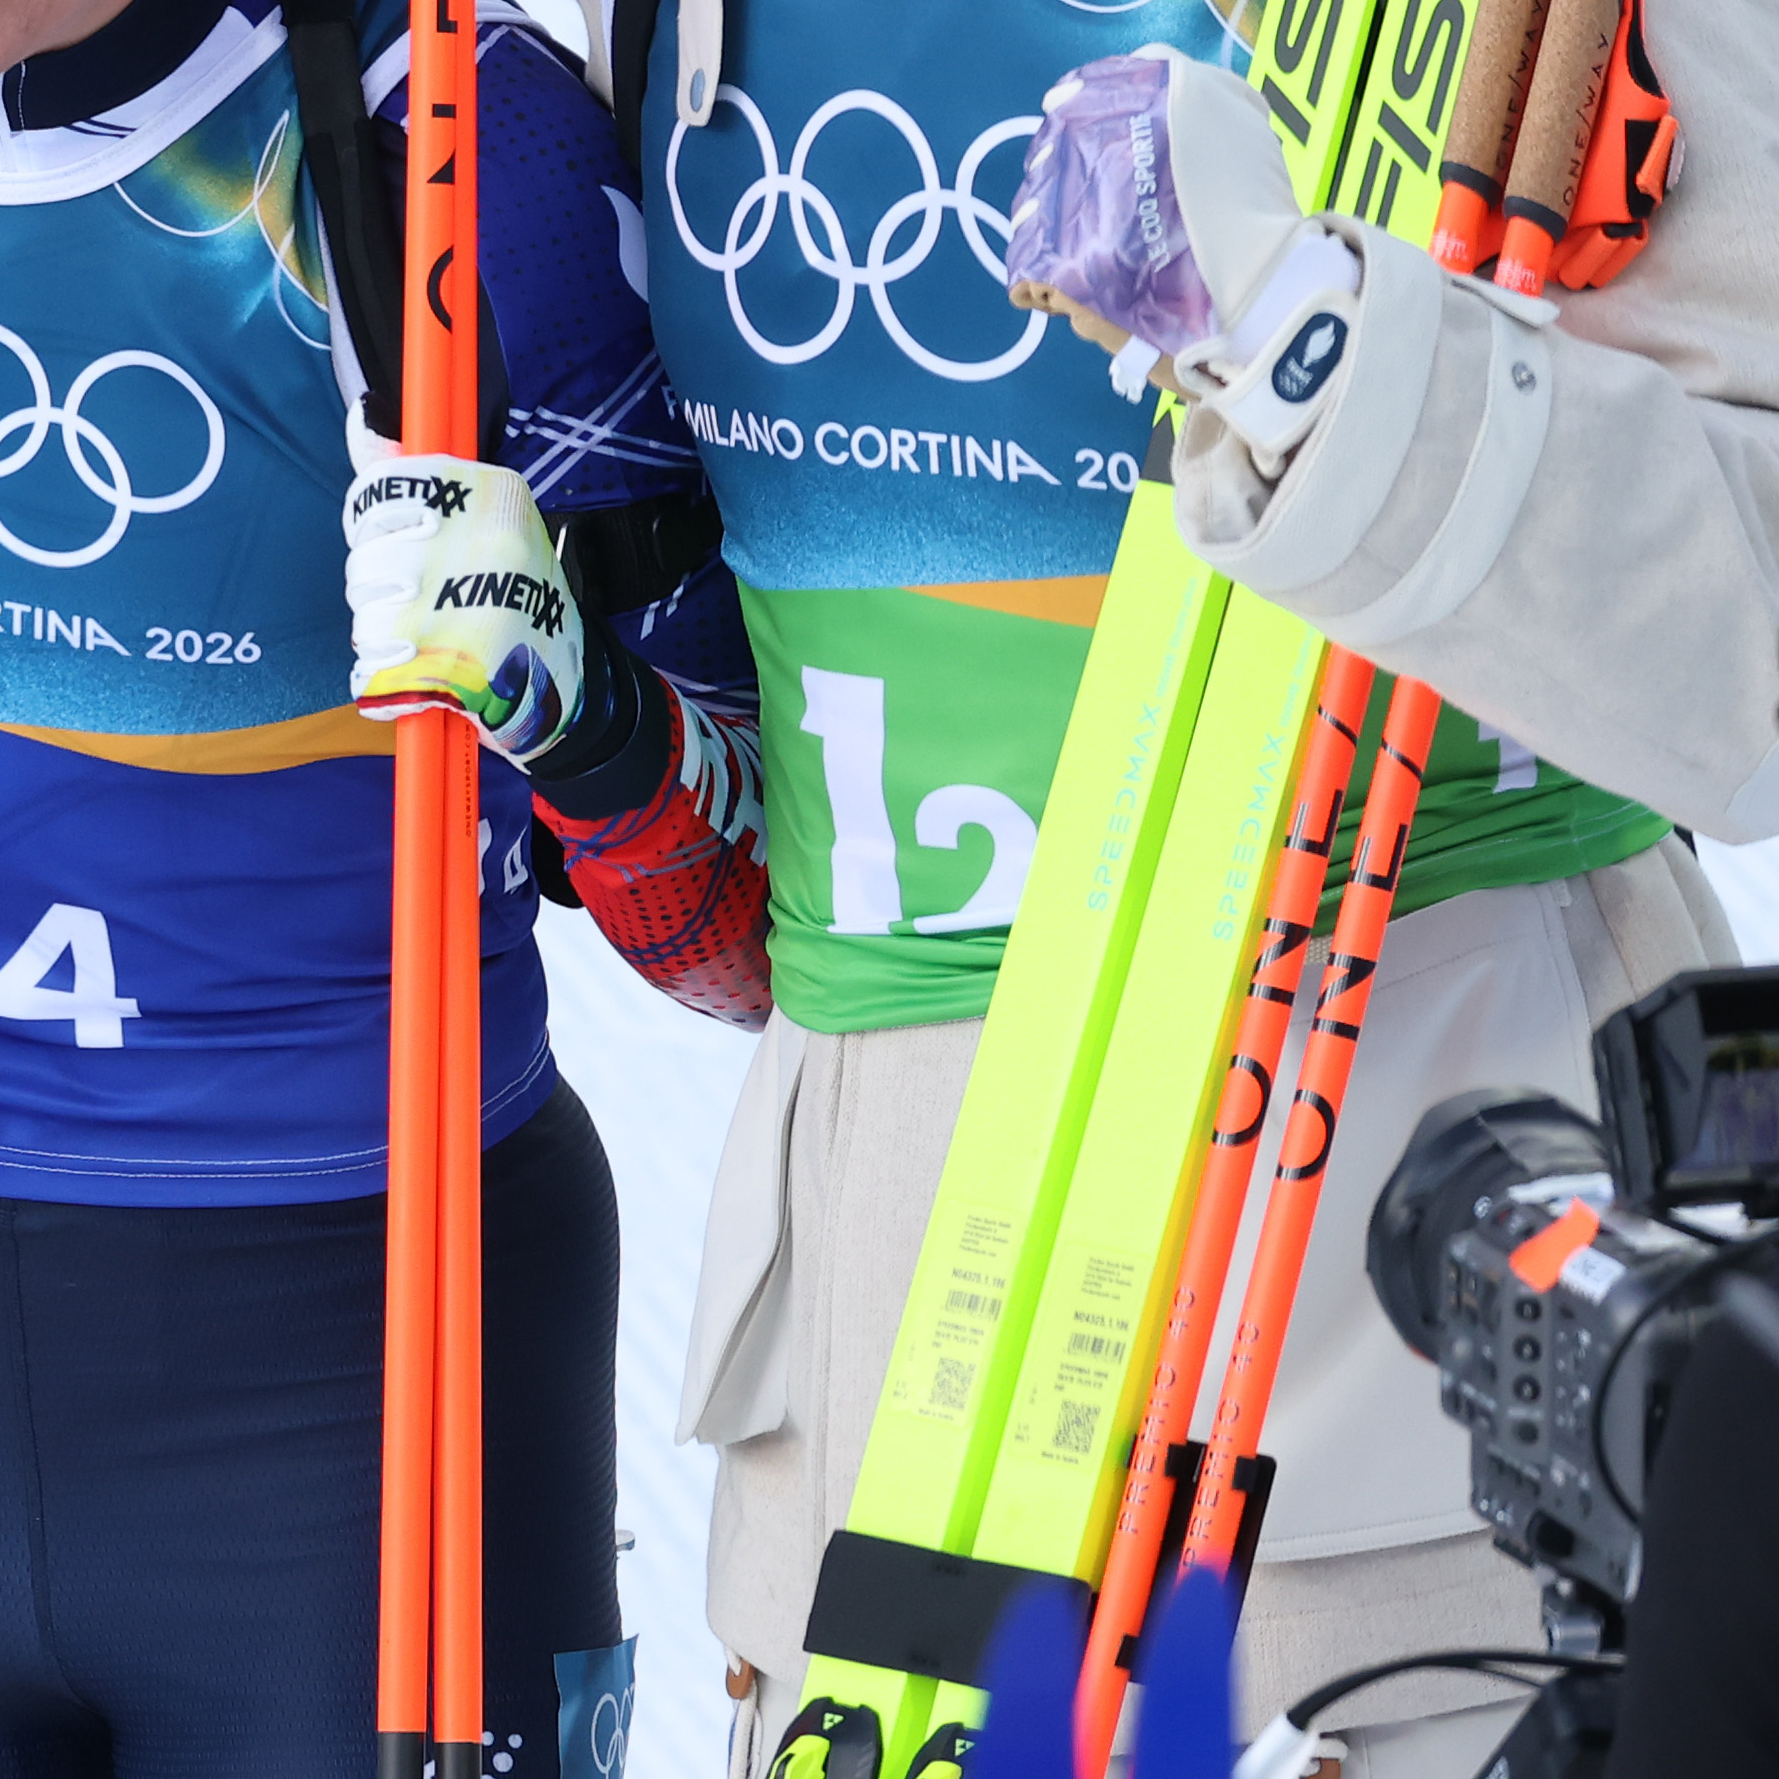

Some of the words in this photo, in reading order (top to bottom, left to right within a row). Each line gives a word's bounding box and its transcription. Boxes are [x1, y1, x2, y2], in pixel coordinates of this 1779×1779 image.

[683, 396, 803, 461] MILANO
[814, 423, 1062, 486] CORTINA
[1074, 448, 1139, 494] 20
[145, 625, 262, 666] 2026
[1086, 702, 1163, 912] SPEEDMAX
[1211, 733, 1287, 942] SPEEDMAX
